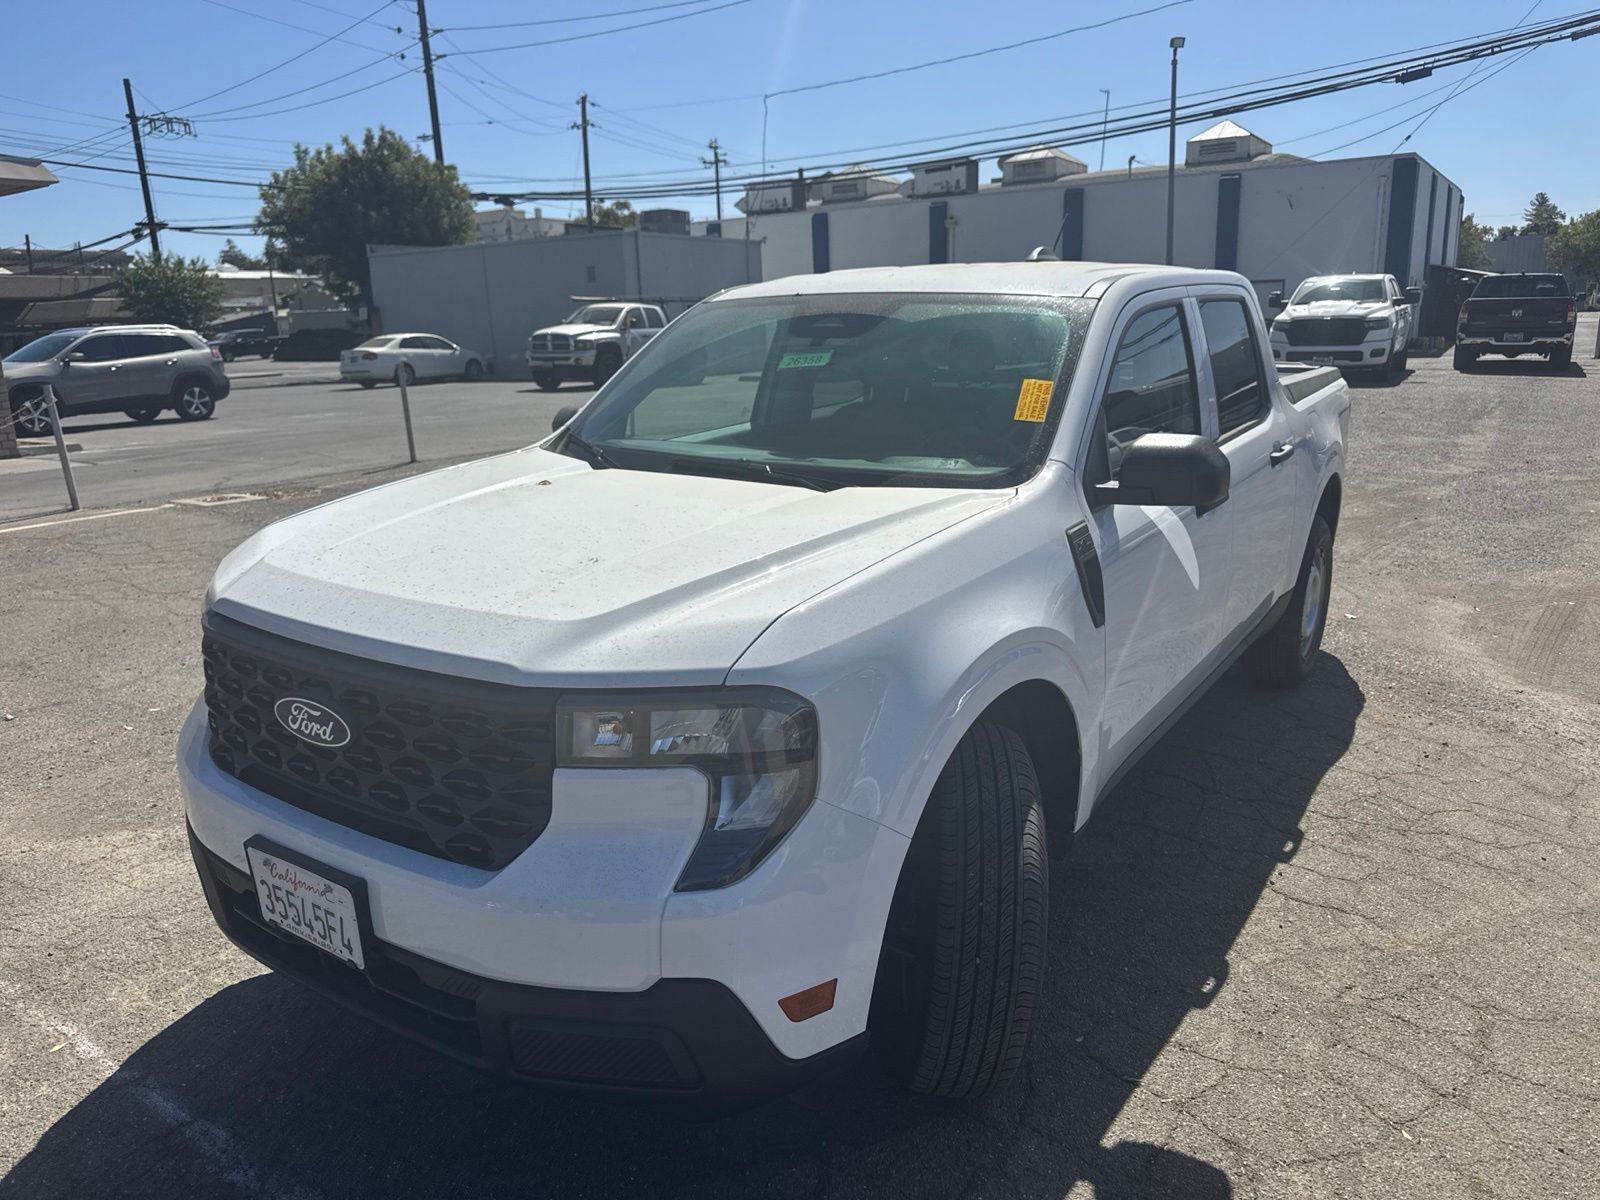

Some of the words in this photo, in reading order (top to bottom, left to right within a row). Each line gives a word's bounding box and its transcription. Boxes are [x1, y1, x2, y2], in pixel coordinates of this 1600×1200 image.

[1043, 383, 1052, 395] THIS
[1030, 405, 1039, 418] SALE
[1036, 396, 1048, 420] VEHICLE
[288, 703, 334, 741] Ford
[270, 862, 330, 899] California
[259, 879, 353, 955] 35545F4
